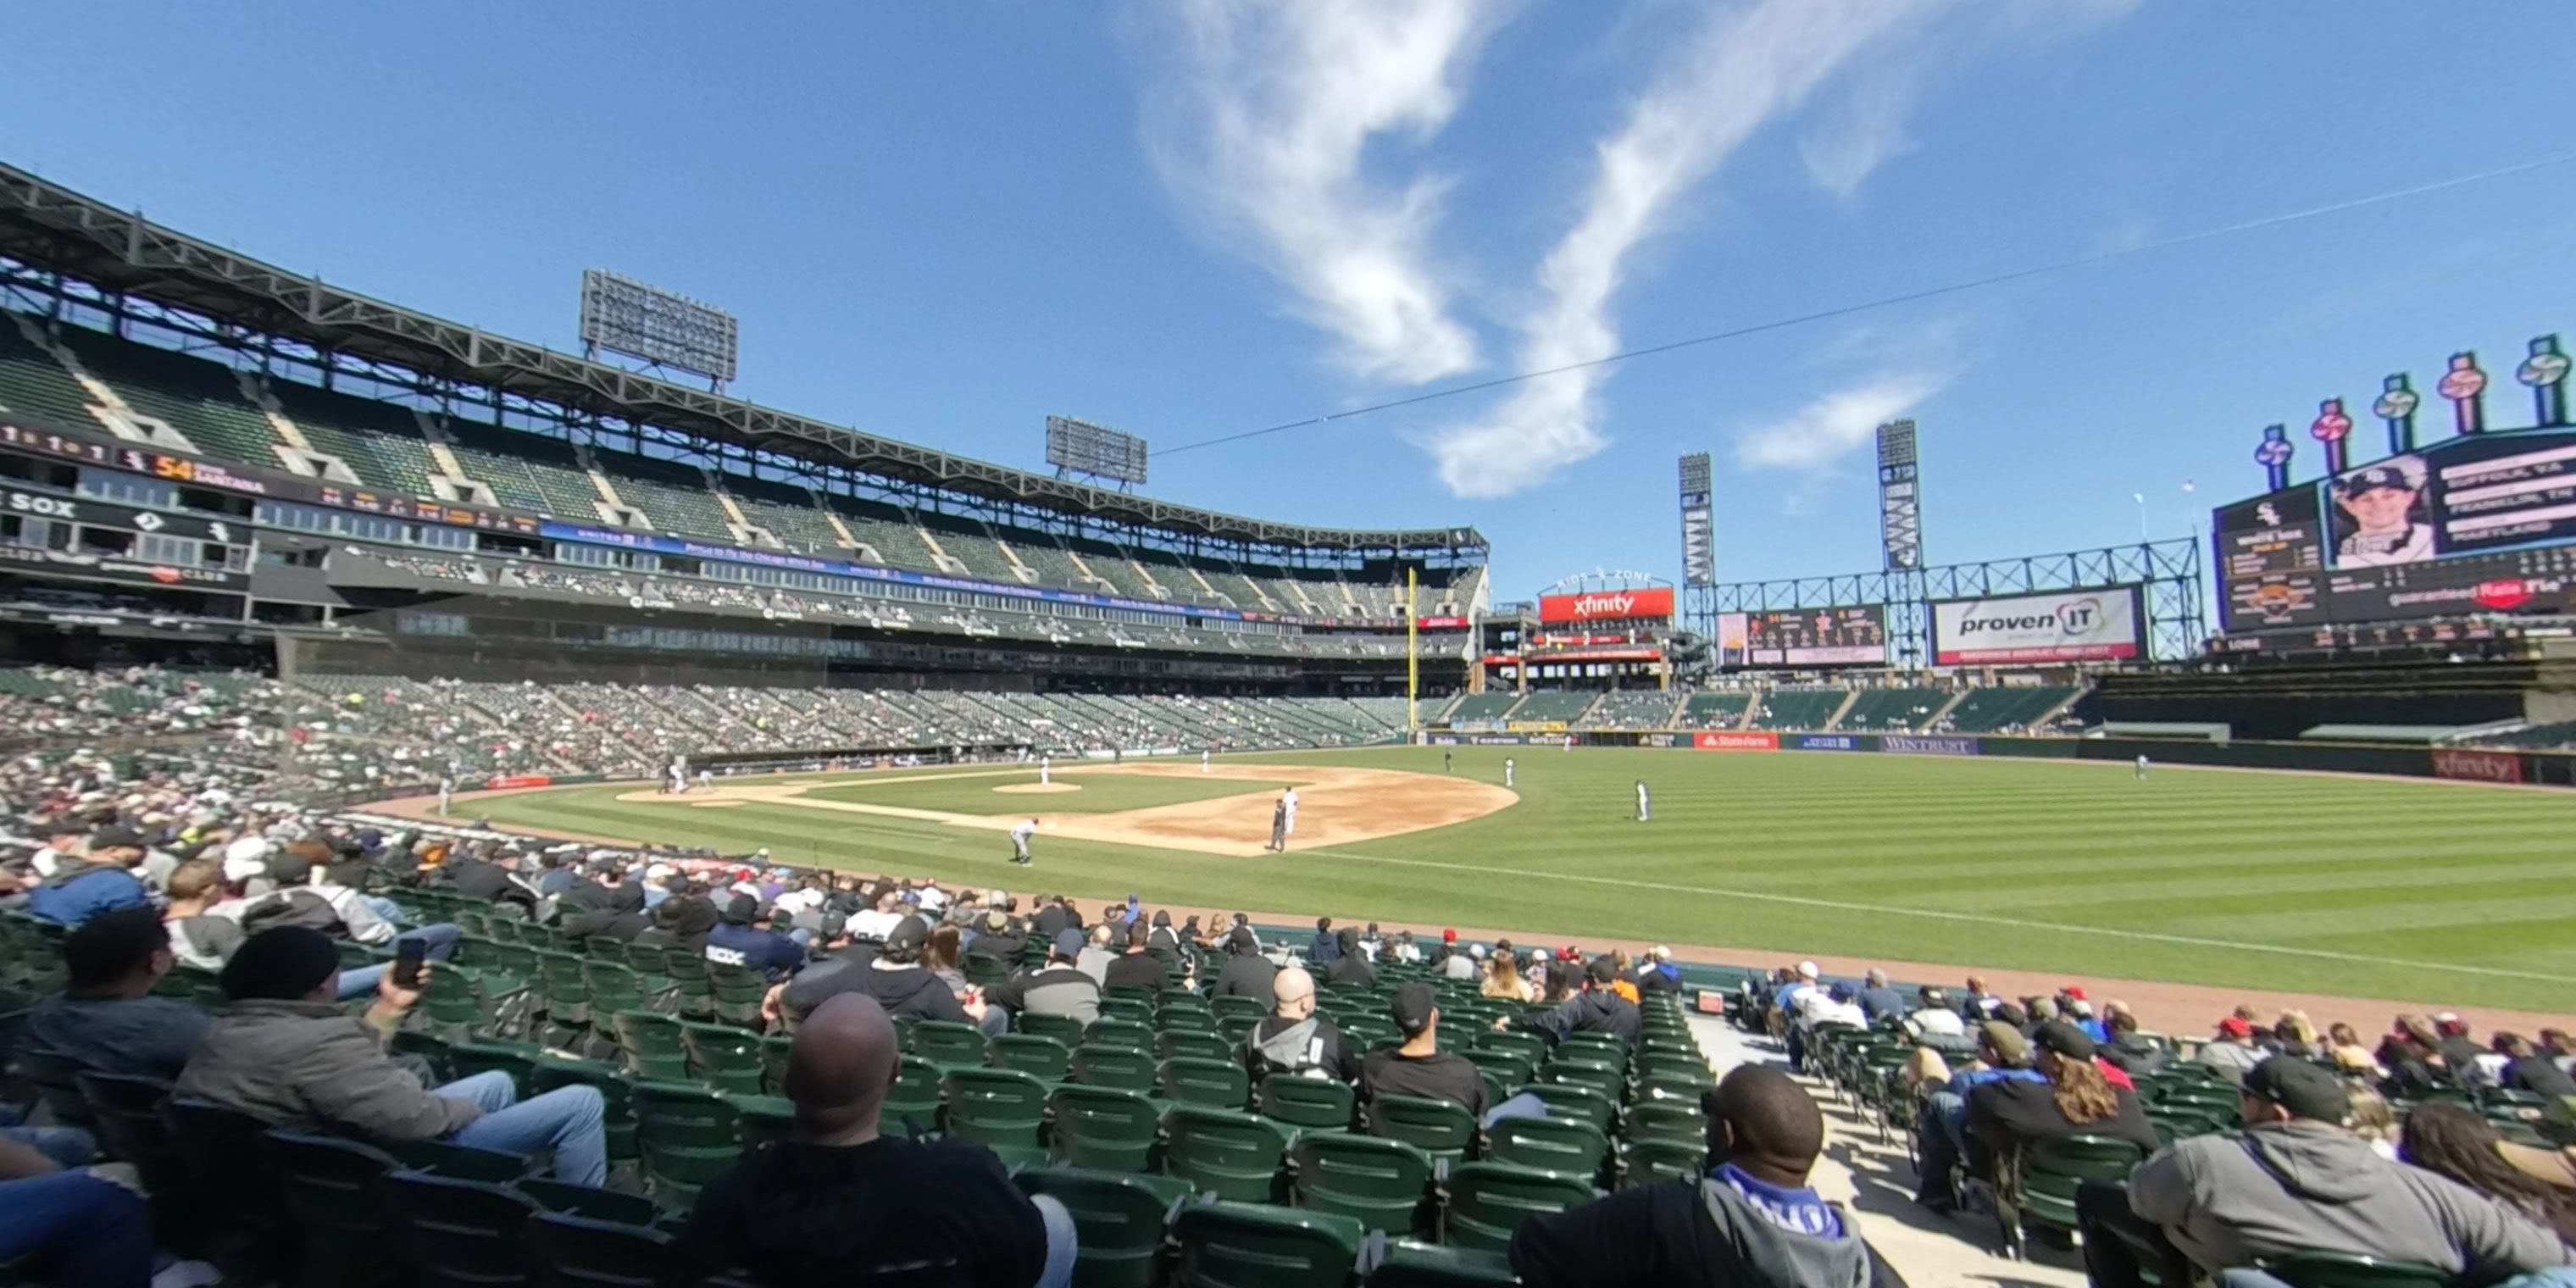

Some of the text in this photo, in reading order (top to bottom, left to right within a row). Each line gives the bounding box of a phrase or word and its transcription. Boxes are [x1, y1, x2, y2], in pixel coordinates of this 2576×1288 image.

[154, 456, 193, 480] 54
[9, 493, 75, 518] SOX
[754, 552, 786, 564] Chicago
[1557, 569, 1652, 588] KIDS ZONE
[1573, 595, 1635, 617] xfinity
[1960, 609, 2092, 636] proven IT
[1885, 736, 1968, 752] WINTRUST
[2433, 752, 2509, 780] xfinity
